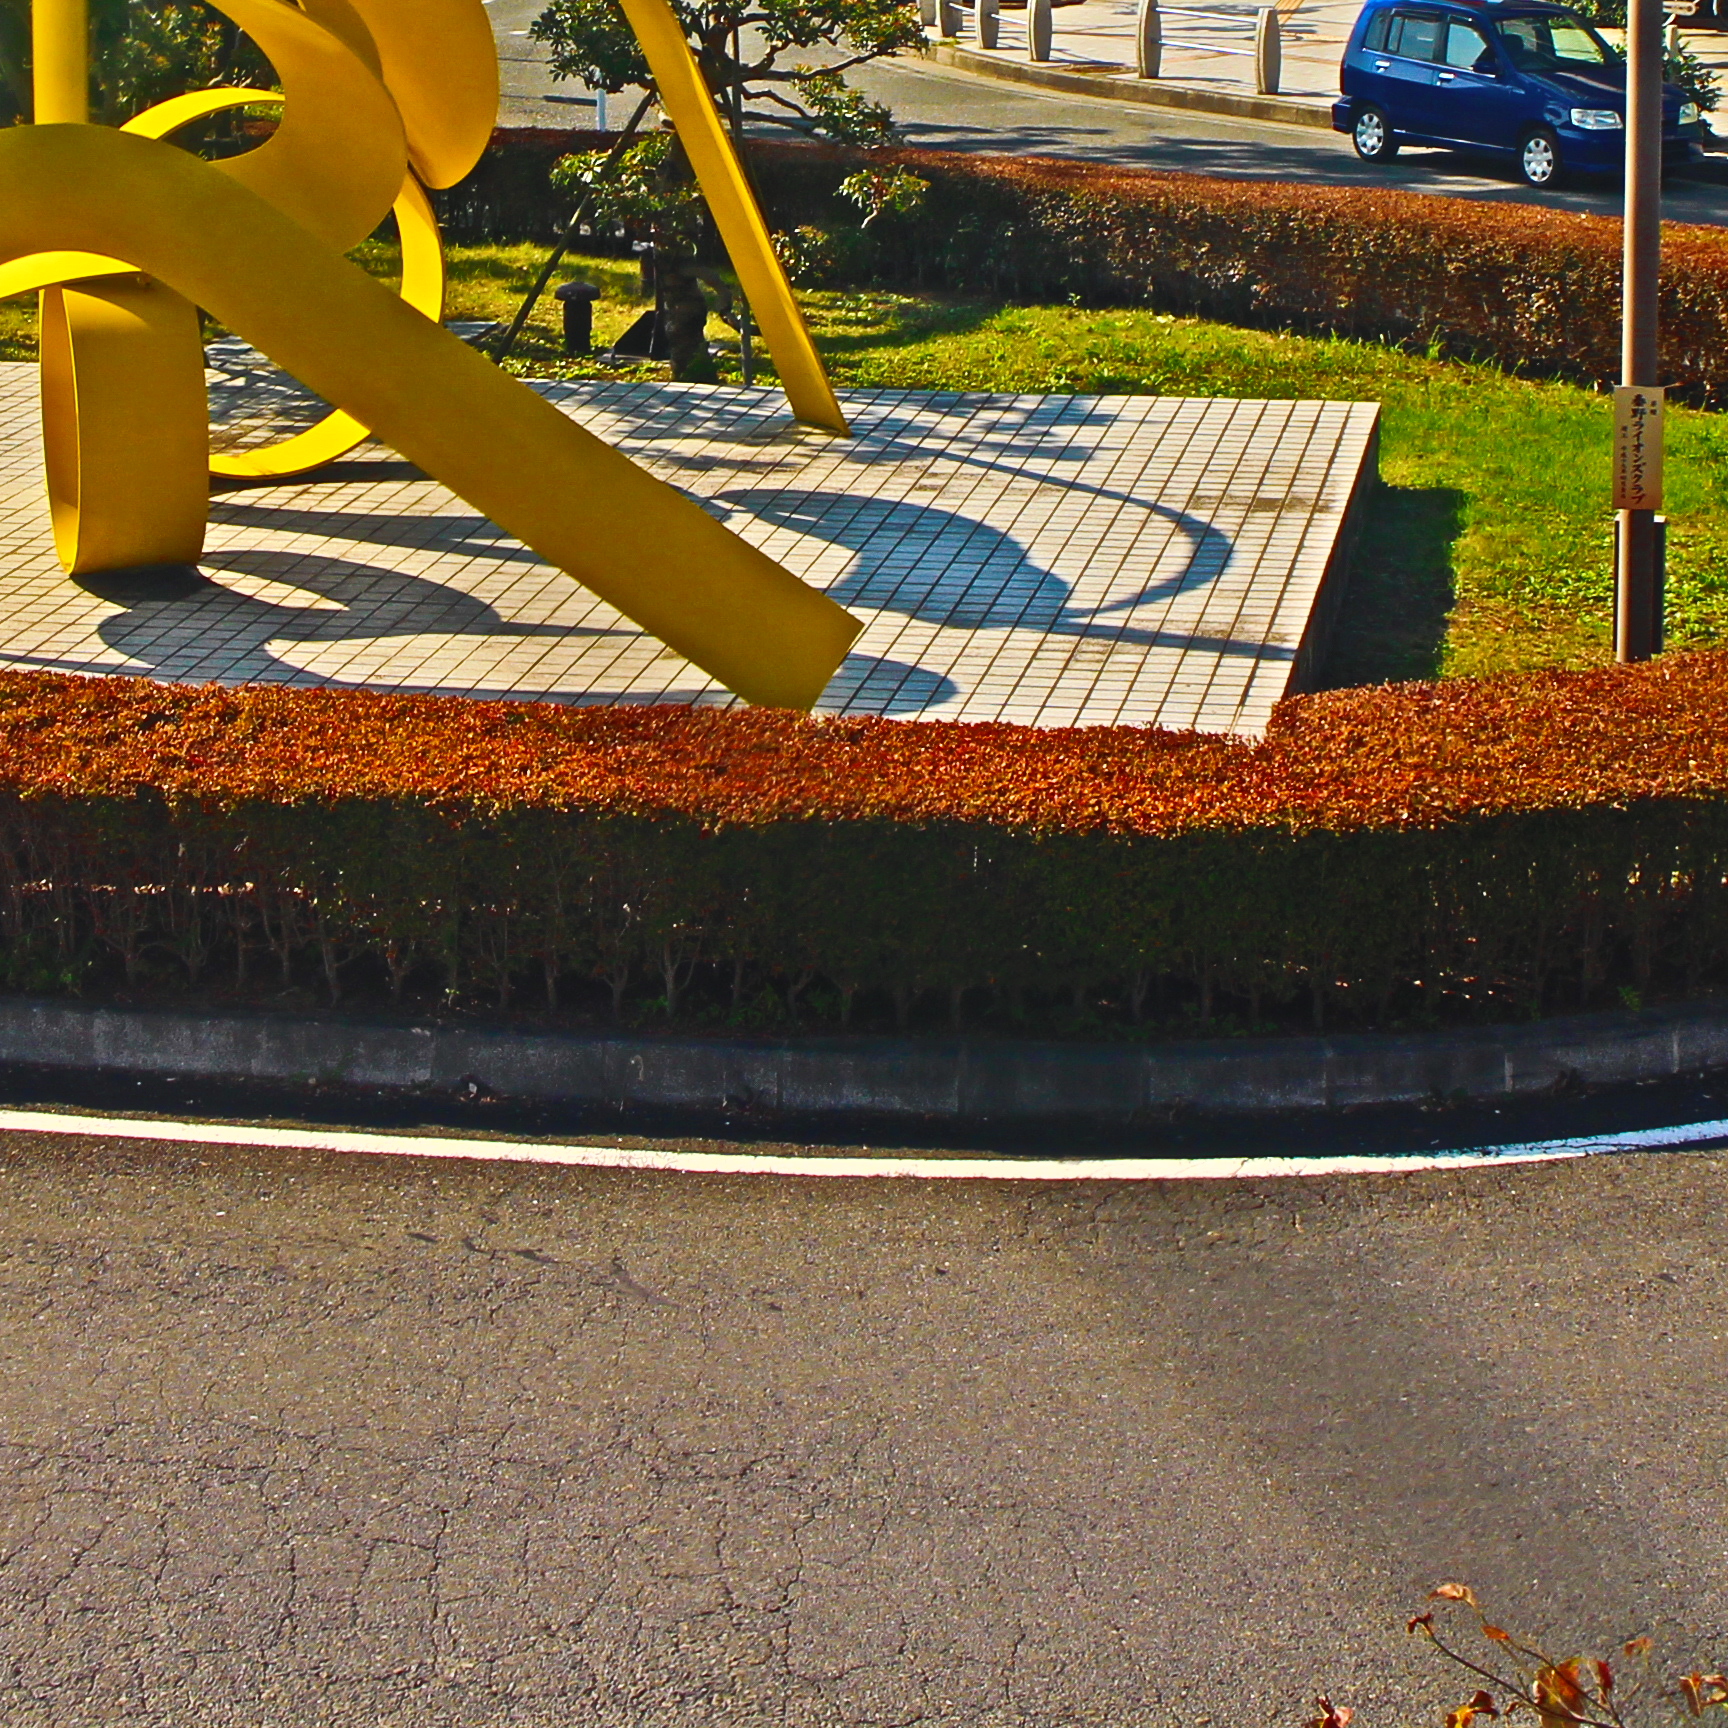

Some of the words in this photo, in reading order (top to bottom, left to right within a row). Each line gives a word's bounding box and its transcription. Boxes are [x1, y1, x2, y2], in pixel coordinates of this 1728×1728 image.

[1631, 393, 1647, 505] 秦野ライオンズクラブ
